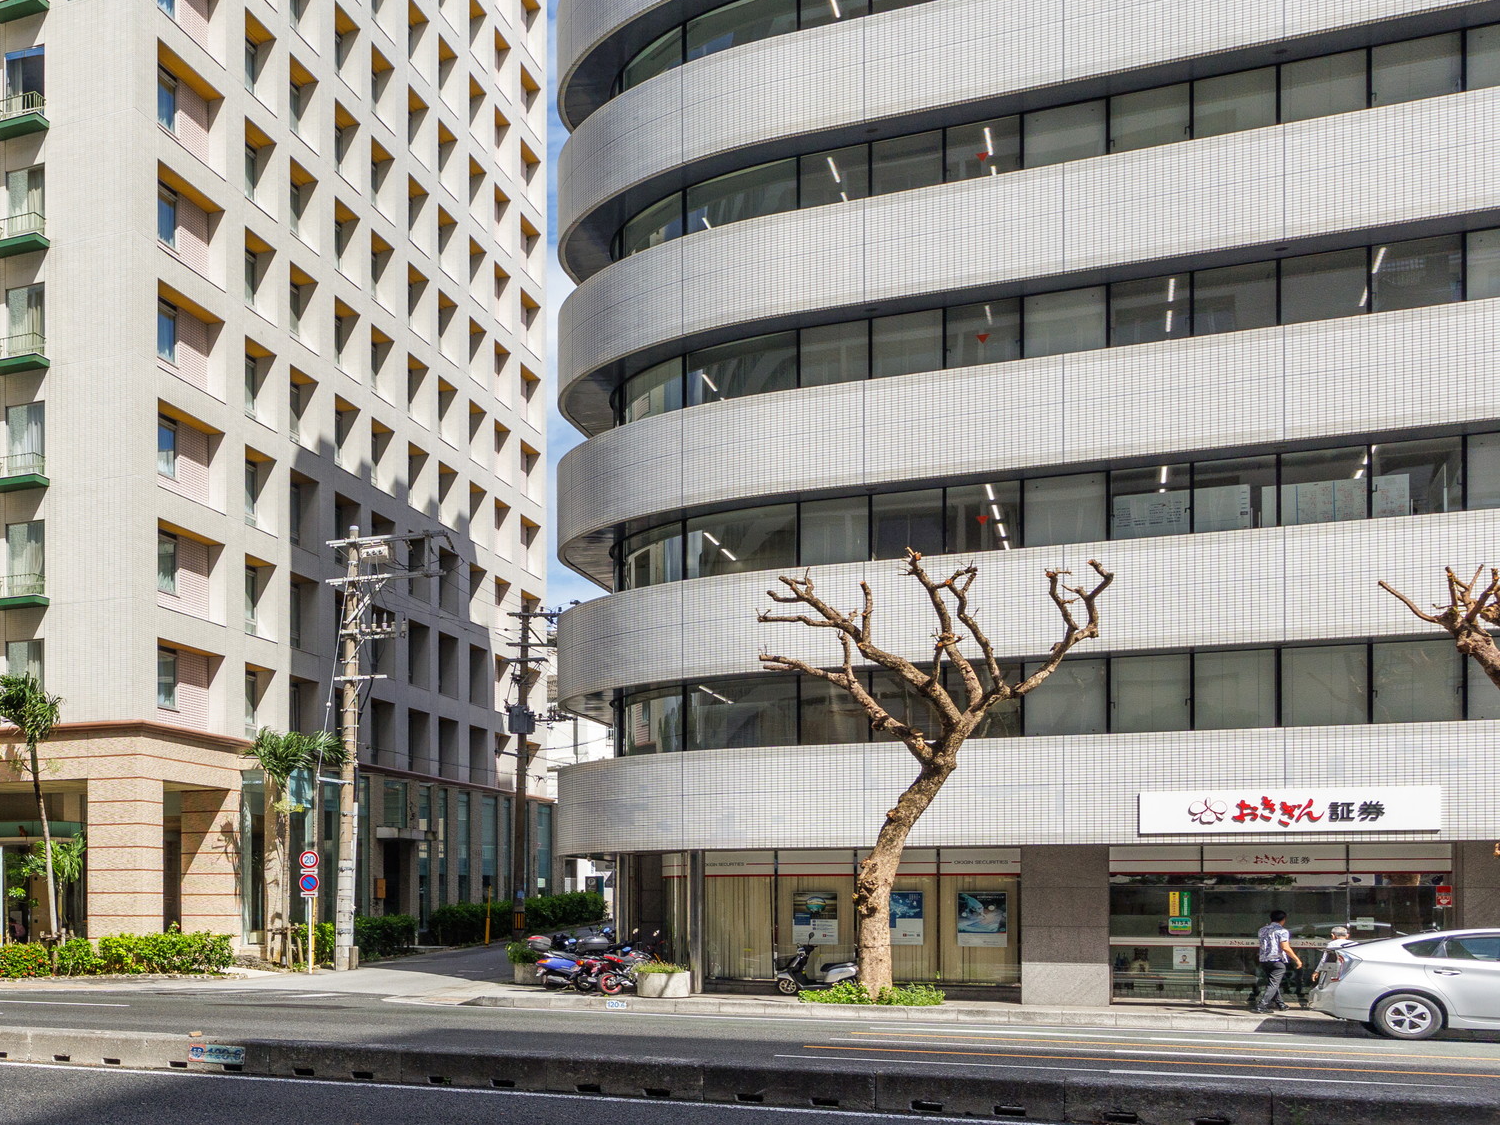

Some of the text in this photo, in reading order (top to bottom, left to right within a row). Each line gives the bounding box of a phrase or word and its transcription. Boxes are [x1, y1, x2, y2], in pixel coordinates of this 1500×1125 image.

[1231, 795, 1386, 828] おきぎん証券
[304, 855, 315, 864] 20
[1253, 853, 1311, 866] おきぎん証券
